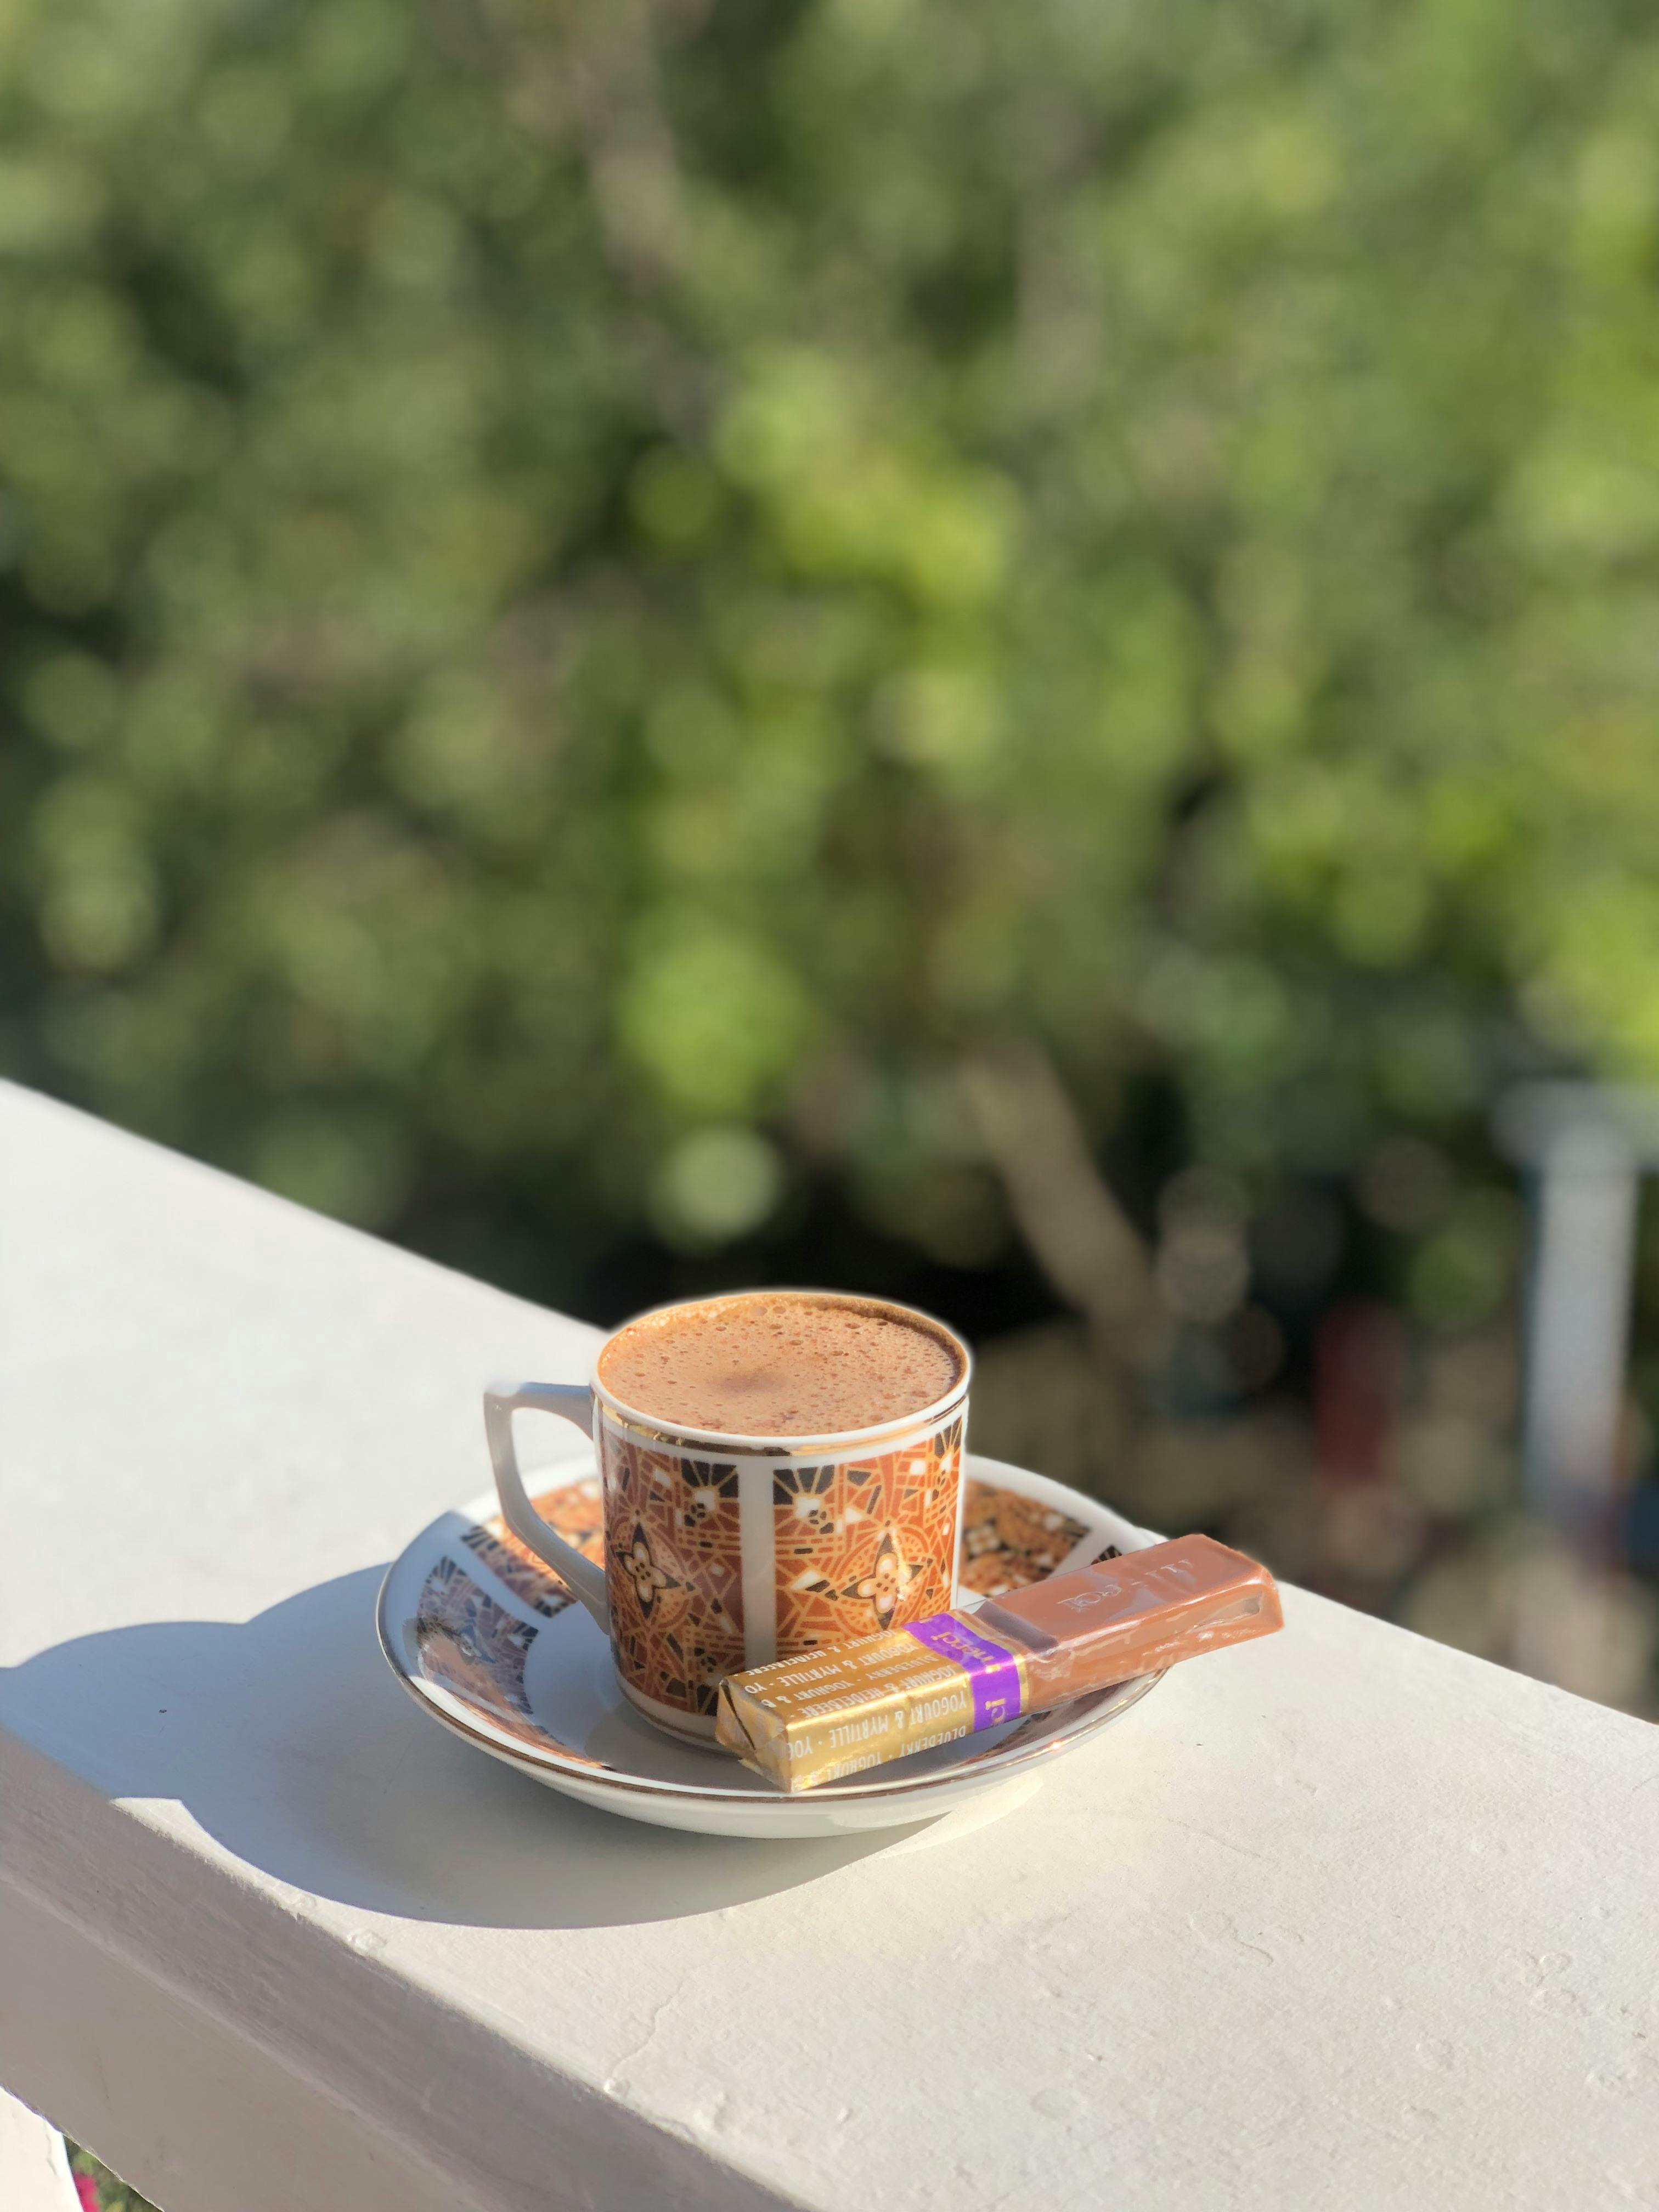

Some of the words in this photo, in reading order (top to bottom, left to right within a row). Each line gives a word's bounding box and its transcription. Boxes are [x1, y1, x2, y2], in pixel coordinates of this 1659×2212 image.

[858, 1643, 918, 1666] YOGOURT
[930, 1632, 1000, 1673] merci
[776, 1664, 842, 1687] MYRTILLE
[842, 1660, 858, 1669] &
[865, 1655, 939, 1680] BLUEBERRY
[793, 1680, 855, 1700] YOGHURT
[883, 1683, 900, 1694] &
[761, 1699, 777, 1708] B
[797, 1688, 885, 1718] HEIDELBEERE
[910, 1690, 966, 1725] YOGOURT
[829, 1714, 888, 1748] MYRTILLE
[894, 1711, 904, 1730] &
